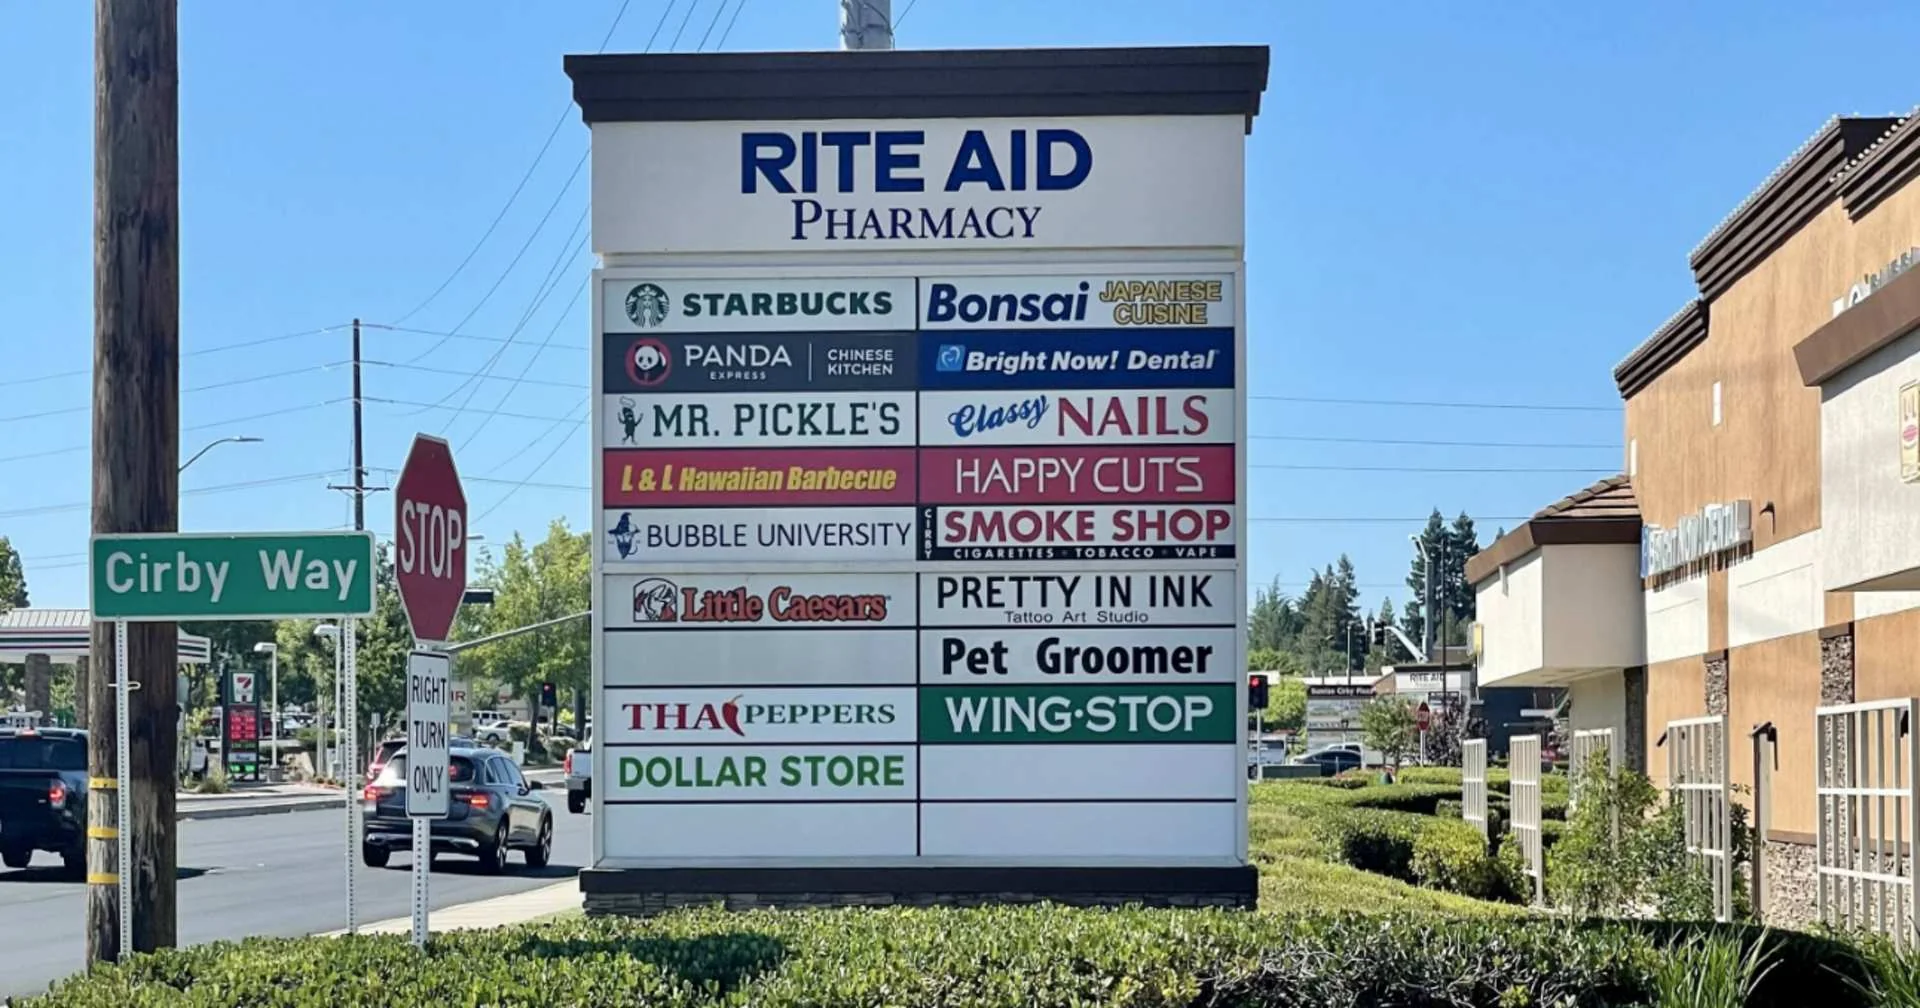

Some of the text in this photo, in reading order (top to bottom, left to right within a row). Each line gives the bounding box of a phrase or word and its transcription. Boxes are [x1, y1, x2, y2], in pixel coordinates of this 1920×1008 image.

[741, 129, 1093, 194] RITE AID
[791, 199, 1042, 240] PHARMACY
[683, 291, 892, 317] STARBUCKS
[927, 281, 1090, 323] Bonsai
[1100, 280, 1222, 302] JAPANESE
[1113, 303, 1208, 325] CUISINE
[684, 345, 792, 367] PANDA
[828, 349, 893, 361] CHINESE
[828, 363, 893, 375] KITCHEN
[966, 349, 1216, 375] Bright Now! Dental
[710, 371, 767, 380] EXPRESS
[653, 403, 900, 437] MR. PICKLE'S
[948, 395, 1209, 437] Classy NAILS
[621, 464, 897, 491] L & L Hawaiian Barbecue
[956, 456, 1203, 493] HAPPY CUTS
[400, 499, 462, 578] STOP
[647, 522, 911, 547] BUBBLE UNIVERSITY
[924, 508, 932, 559] CIRBY
[944, 509, 1231, 543] SMOKE SHOP
[953, 547, 1217, 559] CIGARETTES TOBACCO VAPE
[105, 549, 357, 602] Cirby Way
[680, 586, 887, 622] Little Caesars
[937, 575, 1213, 609] PRETTY IN INK
[1004, 610, 1149, 624] Tattoo Art Studio
[942, 637, 1213, 675] Pet Groomer
[412, 675, 447, 705] RIGHT
[744, 704, 895, 724] PEPPERS
[414, 720, 445, 749] TURN
[414, 765, 444, 793] ONLY
[619, 755, 904, 787] DOLLAR STORE
